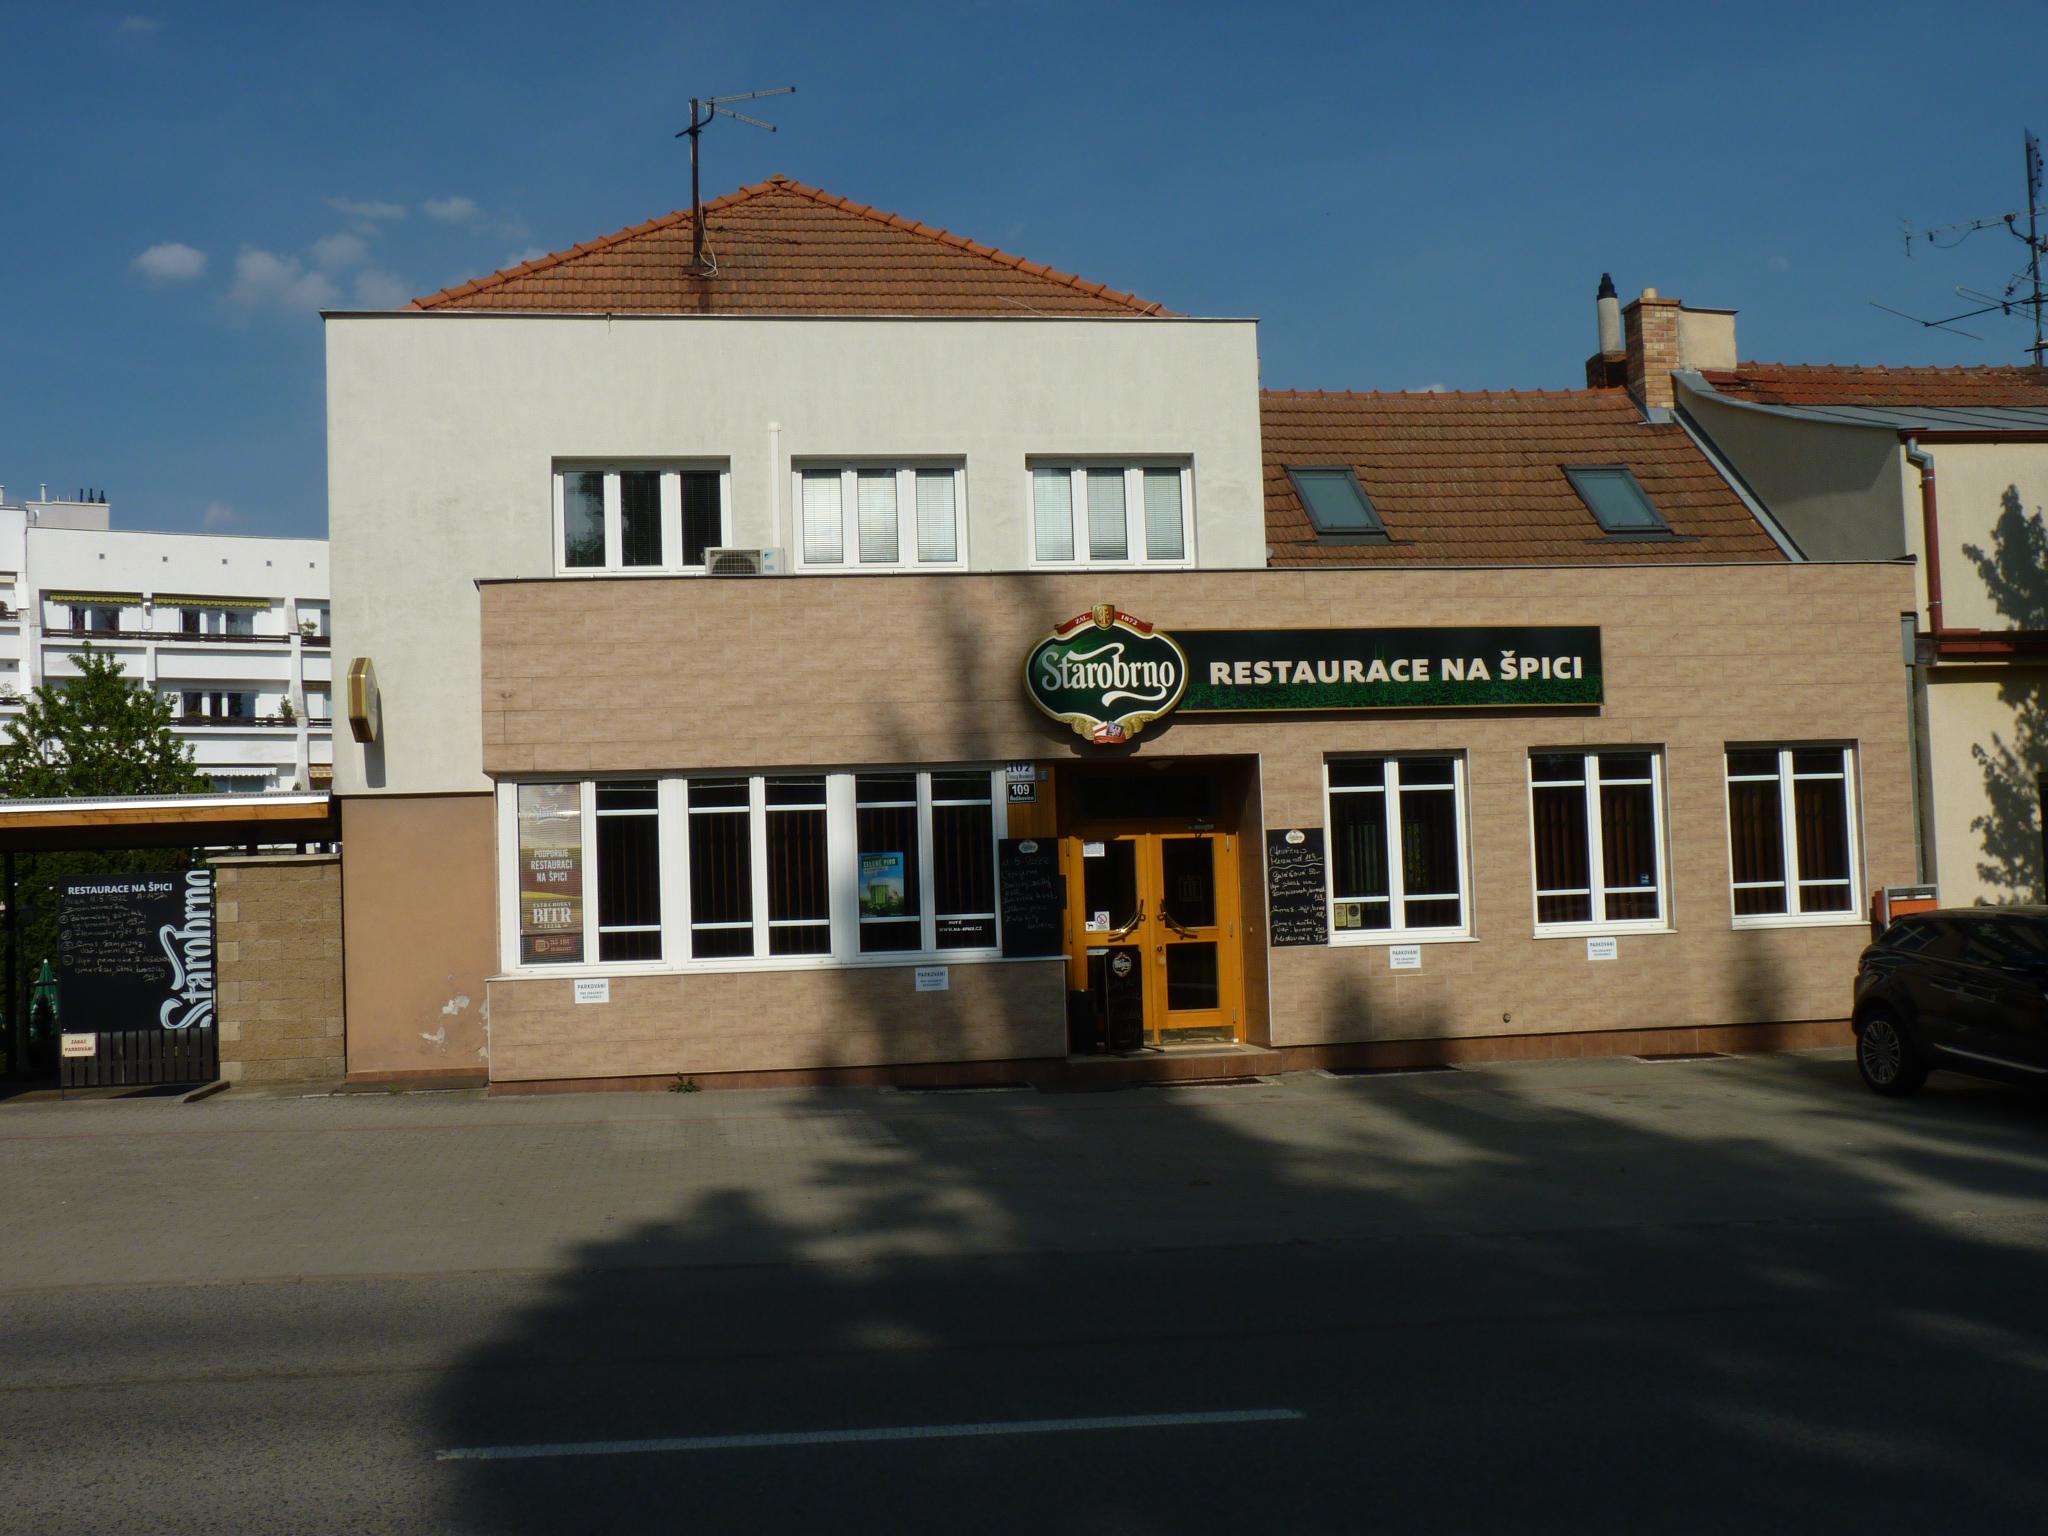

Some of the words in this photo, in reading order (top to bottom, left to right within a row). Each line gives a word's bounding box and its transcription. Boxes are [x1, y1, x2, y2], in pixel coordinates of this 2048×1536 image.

[1120, 614, 1139, 626] 1872
[1209, 658, 1430, 685] RESTAURACE
[1440, 657, 1491, 682] NA
[1499, 650, 1583, 681] ŠPICI
[1041, 642, 1175, 708] Starobrno
[1011, 784, 1030, 796] 109
[530, 859, 573, 870] RESTAURACI
[536, 872, 547, 882] NA
[548, 870, 568, 882] ŠPICI
[68, 884, 129, 895] RESTAURACE
[131, 884, 146, 892] NA
[148, 881, 173, 892] ŠPICI
[532, 907, 572, 924] BITR
[159, 869, 212, 1029] Starobrno
